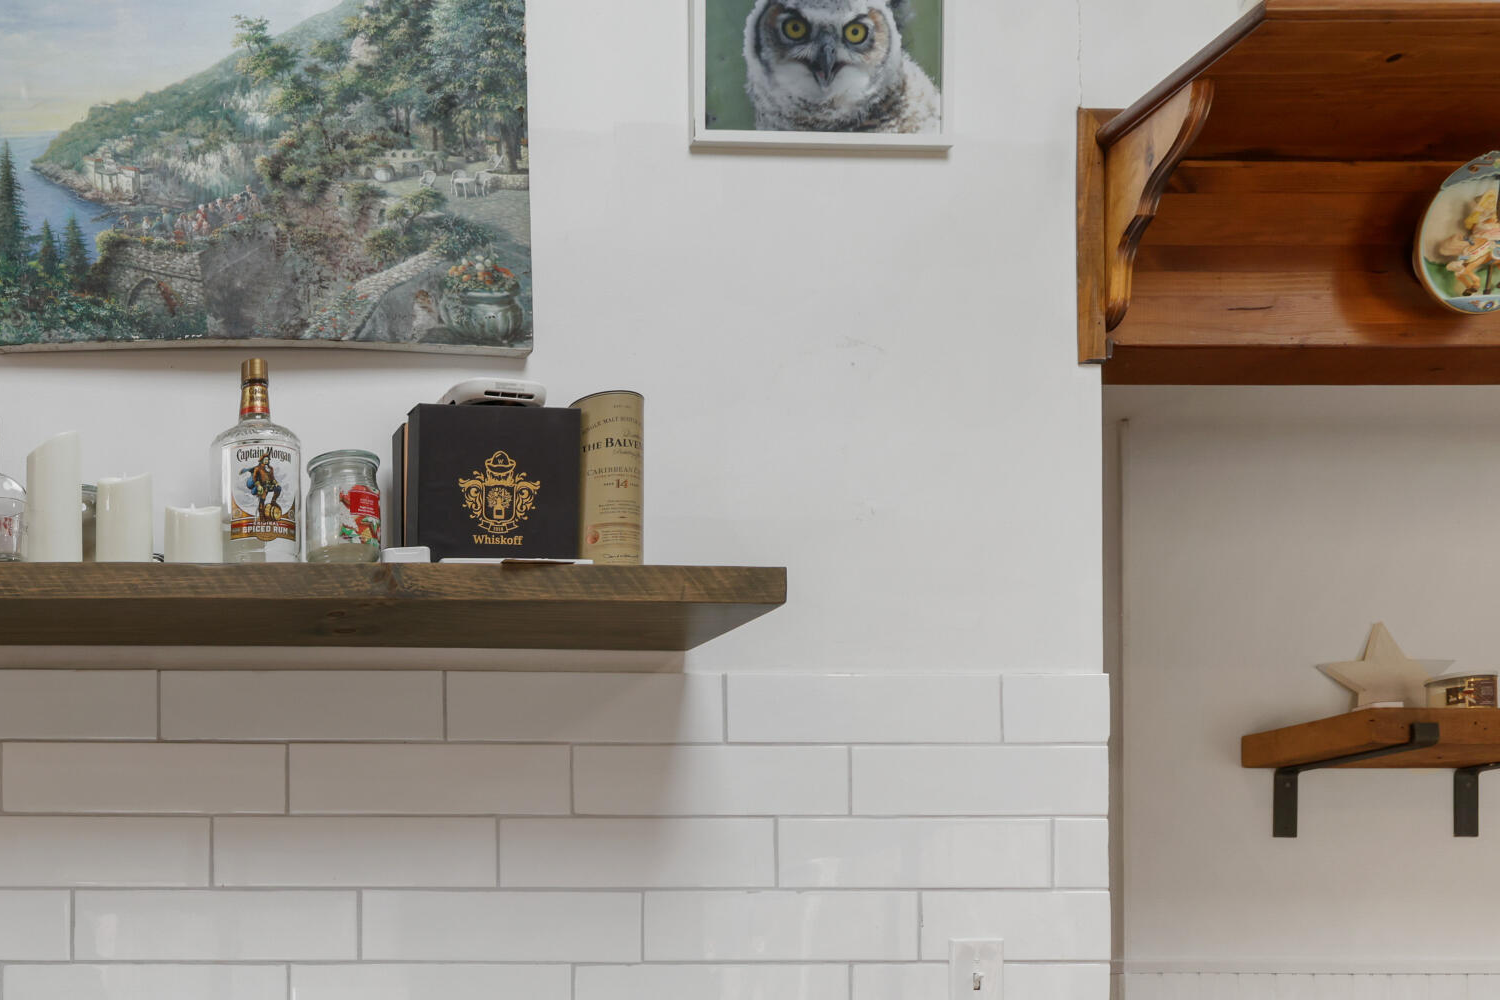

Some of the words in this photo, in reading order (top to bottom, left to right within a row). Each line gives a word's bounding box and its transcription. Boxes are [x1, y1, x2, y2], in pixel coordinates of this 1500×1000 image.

[582, 441, 603, 453] THE
[236, 448, 264, 462] Captain
[264, 446, 292, 464] Morgan
[615, 479, 629, 489] 14
[242, 525, 271, 534] SPICED
[273, 525, 288, 535] RUM
[473, 534, 524, 545] Whiskoff
